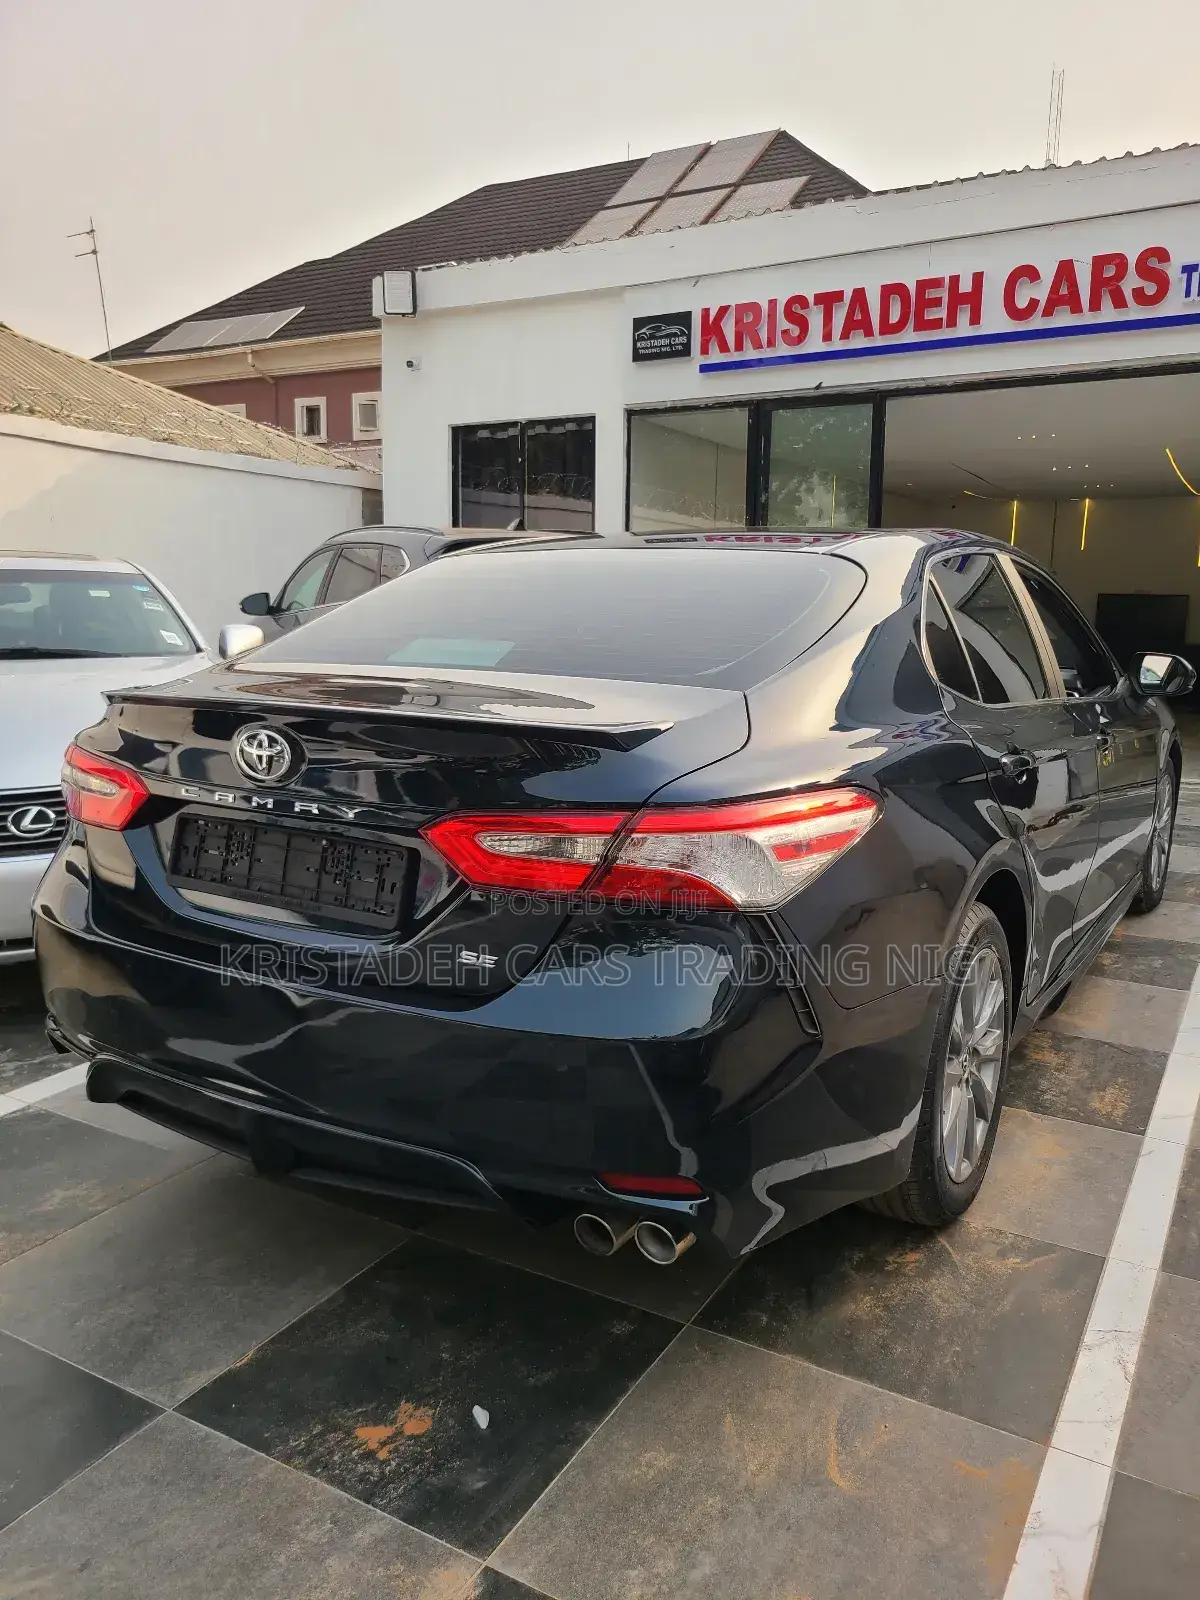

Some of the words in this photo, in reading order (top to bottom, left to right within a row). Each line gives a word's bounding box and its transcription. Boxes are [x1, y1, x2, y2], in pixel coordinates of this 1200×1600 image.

[699, 270, 985, 356] KRISTADEH
[1003, 246, 1171, 322] CARS
[1181, 263, 1200, 298] T
[636, 338, 670, 349] KRISTADEH
[670, 336, 688, 345] CARS
[638, 347, 661, 355] TRADING
[181, 786, 362, 821] CAMRY
[457, 950, 499, 969] SE
